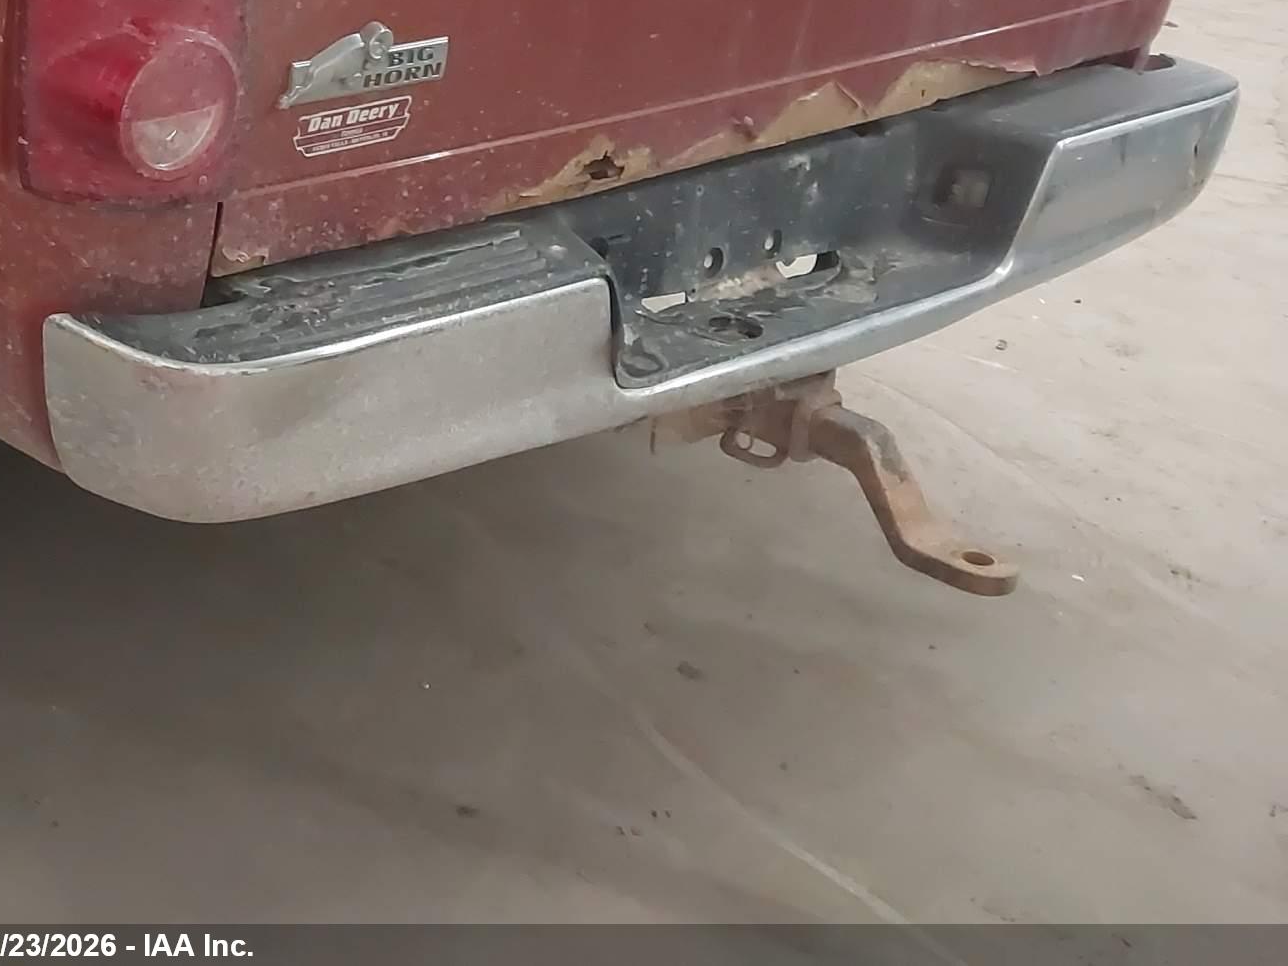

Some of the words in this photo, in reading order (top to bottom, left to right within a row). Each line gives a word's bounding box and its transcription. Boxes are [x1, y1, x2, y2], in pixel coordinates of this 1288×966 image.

[388, 46, 435, 68] BIG
[363, 62, 443, 89] HORN
[307, 114, 344, 133] Dan
[346, 103, 401, 125] Deery
